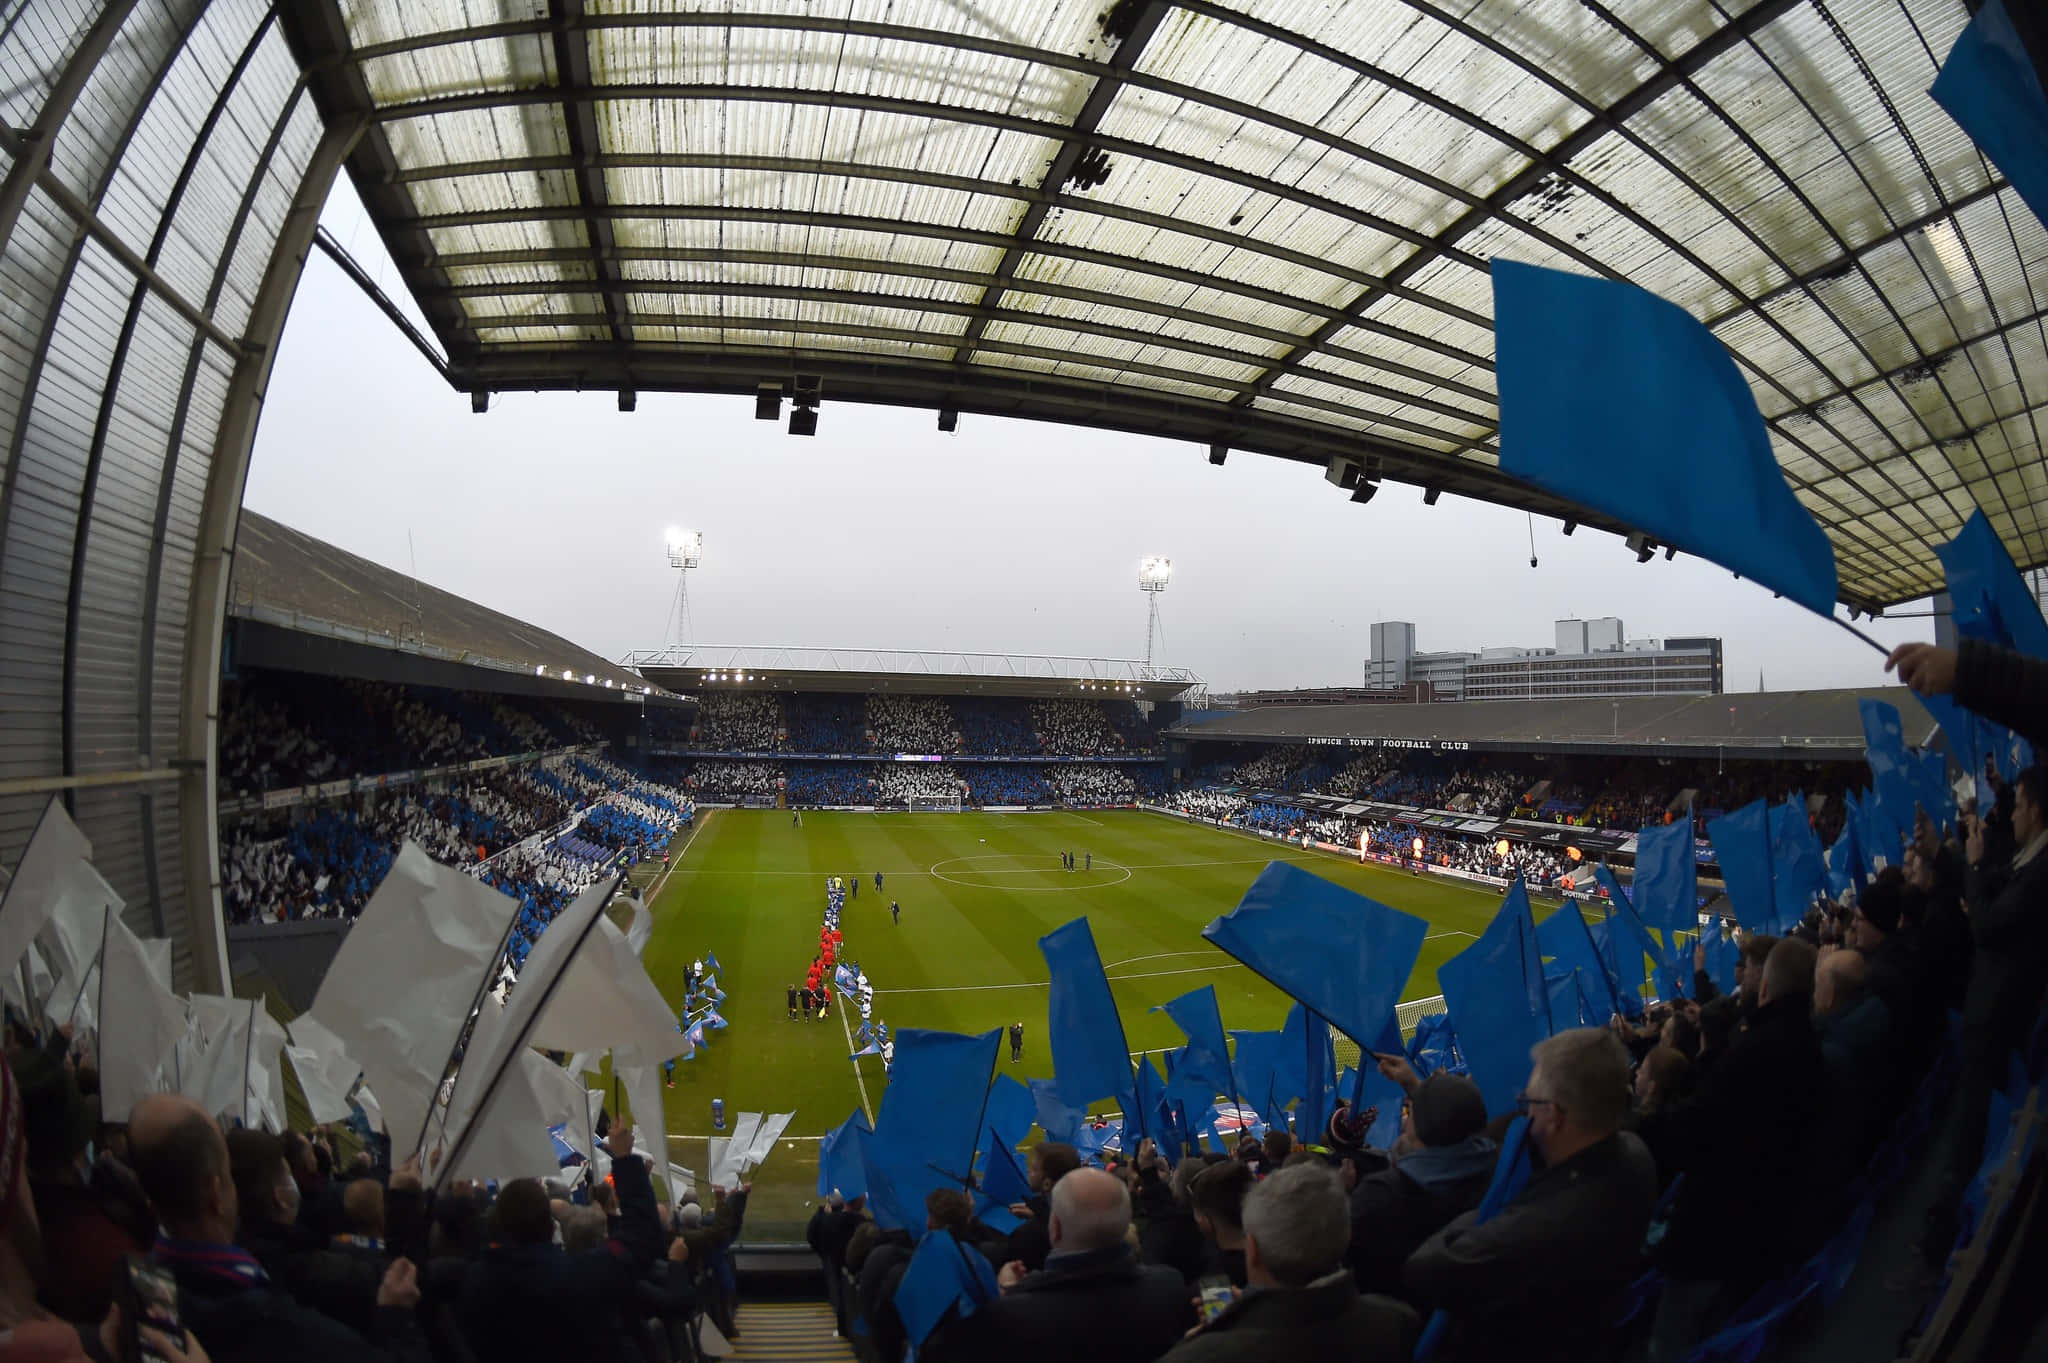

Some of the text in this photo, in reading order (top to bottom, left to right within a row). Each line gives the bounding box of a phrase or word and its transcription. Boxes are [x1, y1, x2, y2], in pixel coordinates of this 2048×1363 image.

[1349, 739, 1375, 747] TOWN
[1383, 739, 1431, 748] FOOTBALL
[1441, 741, 1469, 750] CLUB
